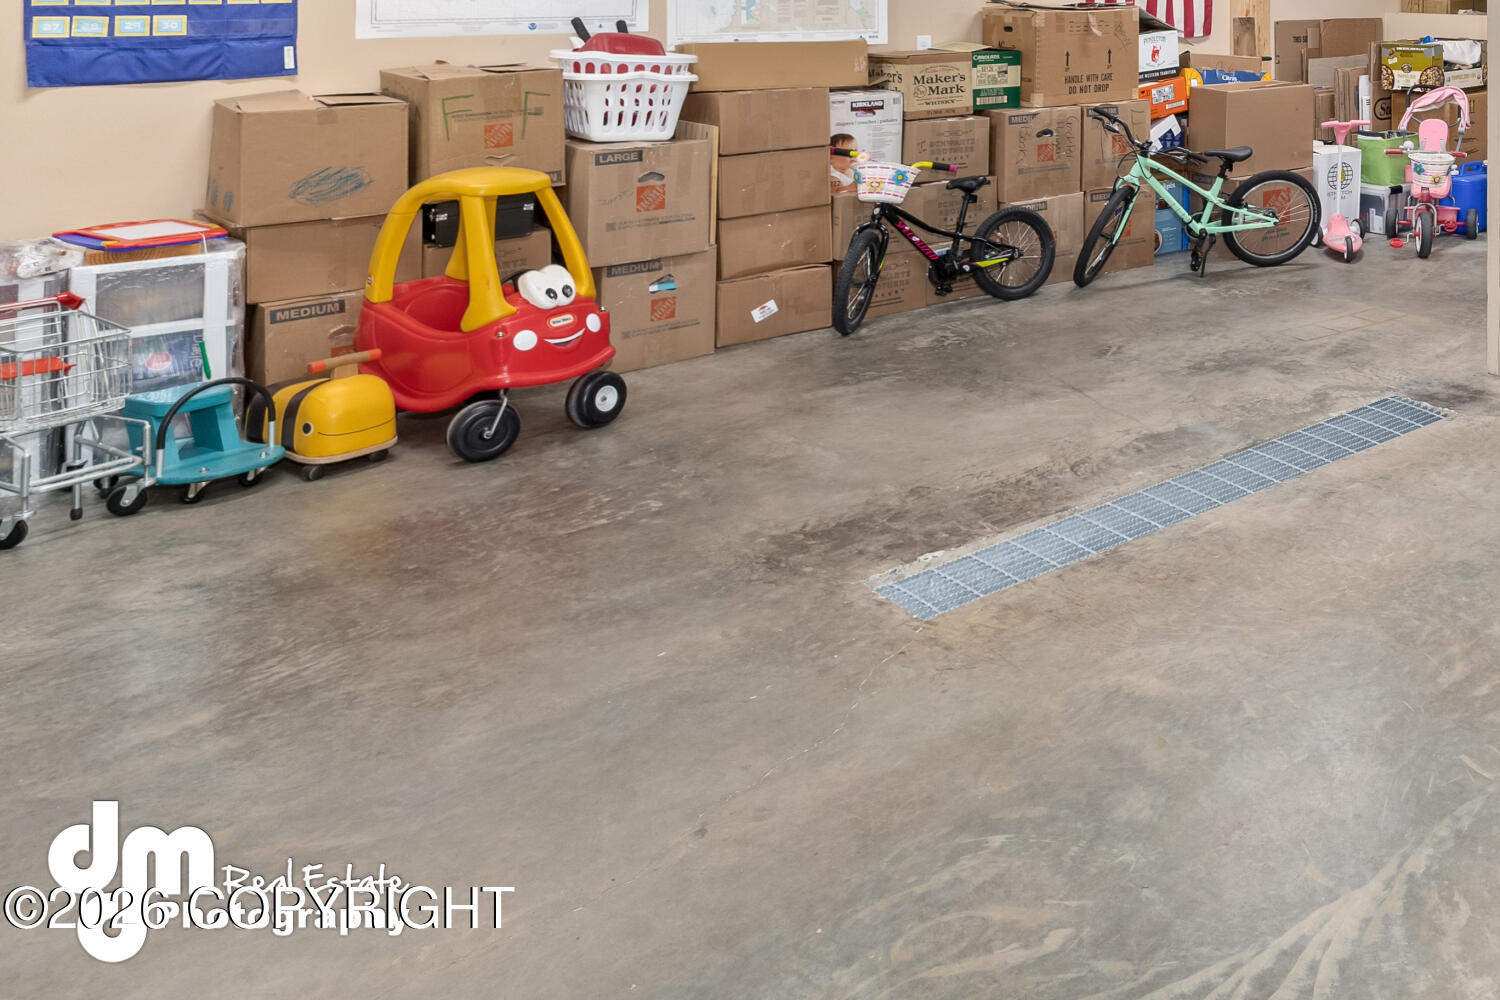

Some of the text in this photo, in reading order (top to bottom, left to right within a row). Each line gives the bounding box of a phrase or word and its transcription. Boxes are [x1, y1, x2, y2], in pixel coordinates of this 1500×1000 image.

[912, 72, 966, 86] Maker's
[1064, 72, 1113, 84] HANDLE WITH CARE
[928, 84, 966, 96] Mark
[1068, 83, 1110, 95] DO NOT DROP
[442, 94, 475, 142] F
[522, 90, 551, 140] F
[600, 152, 638, 163] LARGE
[612, 261, 660, 276] MEDIUM
[276, 302, 340, 321] MEDIUM
